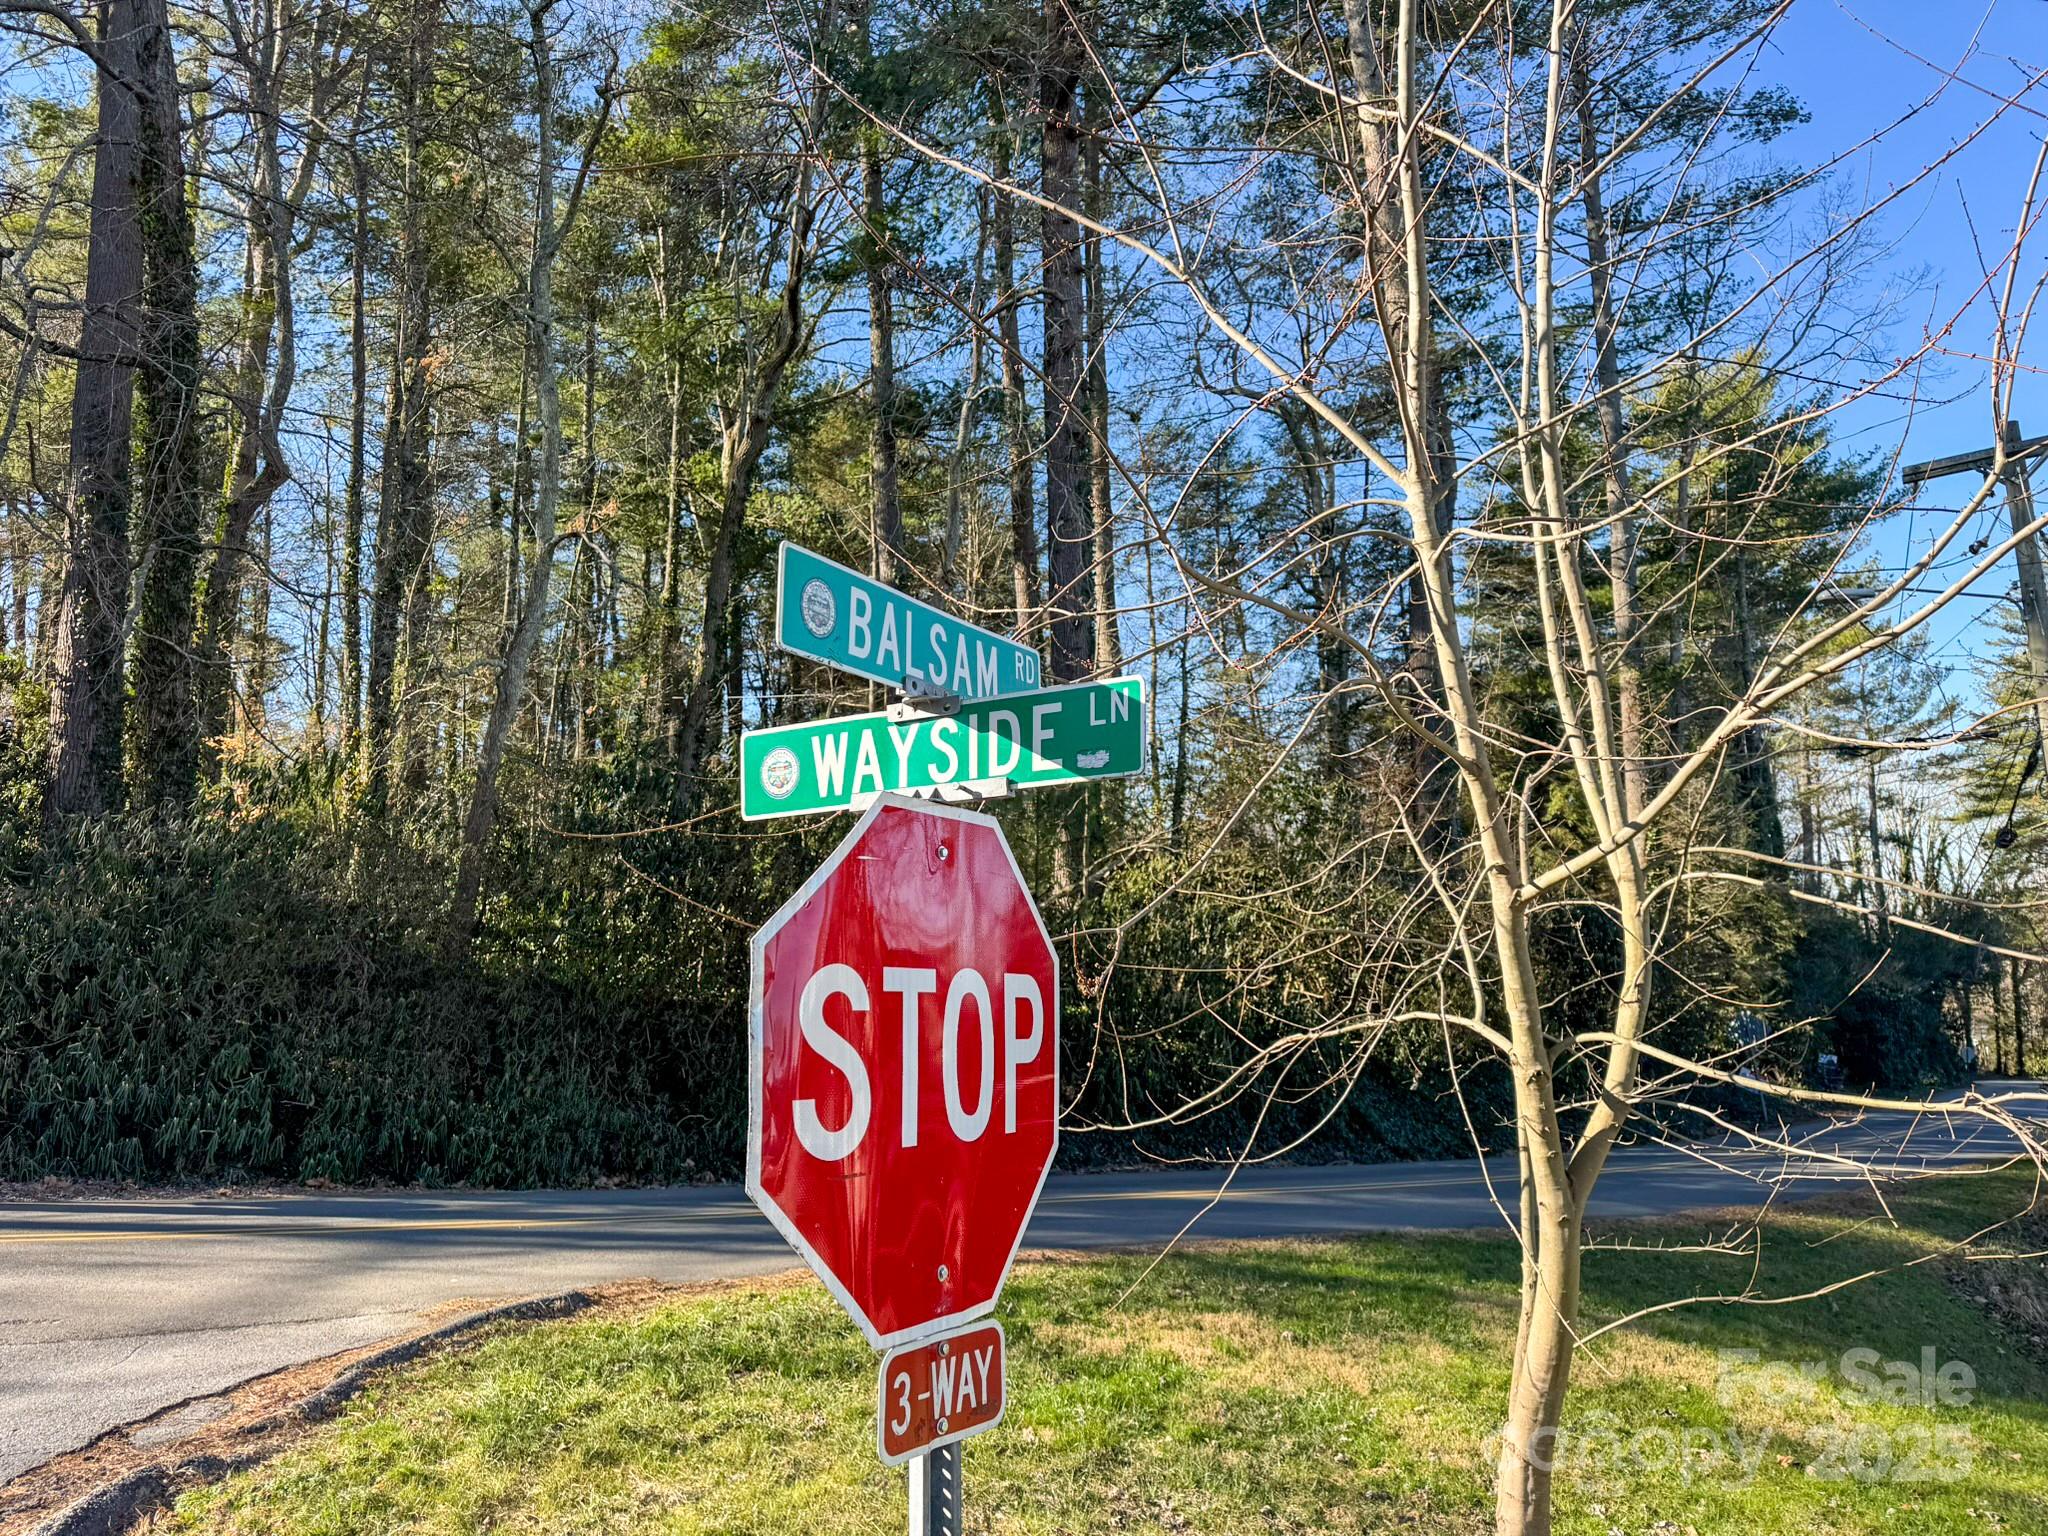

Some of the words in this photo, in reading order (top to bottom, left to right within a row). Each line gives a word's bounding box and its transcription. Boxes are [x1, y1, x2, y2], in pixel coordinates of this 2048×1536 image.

[848, 586, 998, 696] BALSAM
[1015, 650, 1036, 685] RD
[811, 702, 1064, 799] WAYSIDE
[1089, 687, 1130, 726] LN
[792, 963, 1044, 1162] STOP
[891, 1344, 994, 1437] 3-WAY
